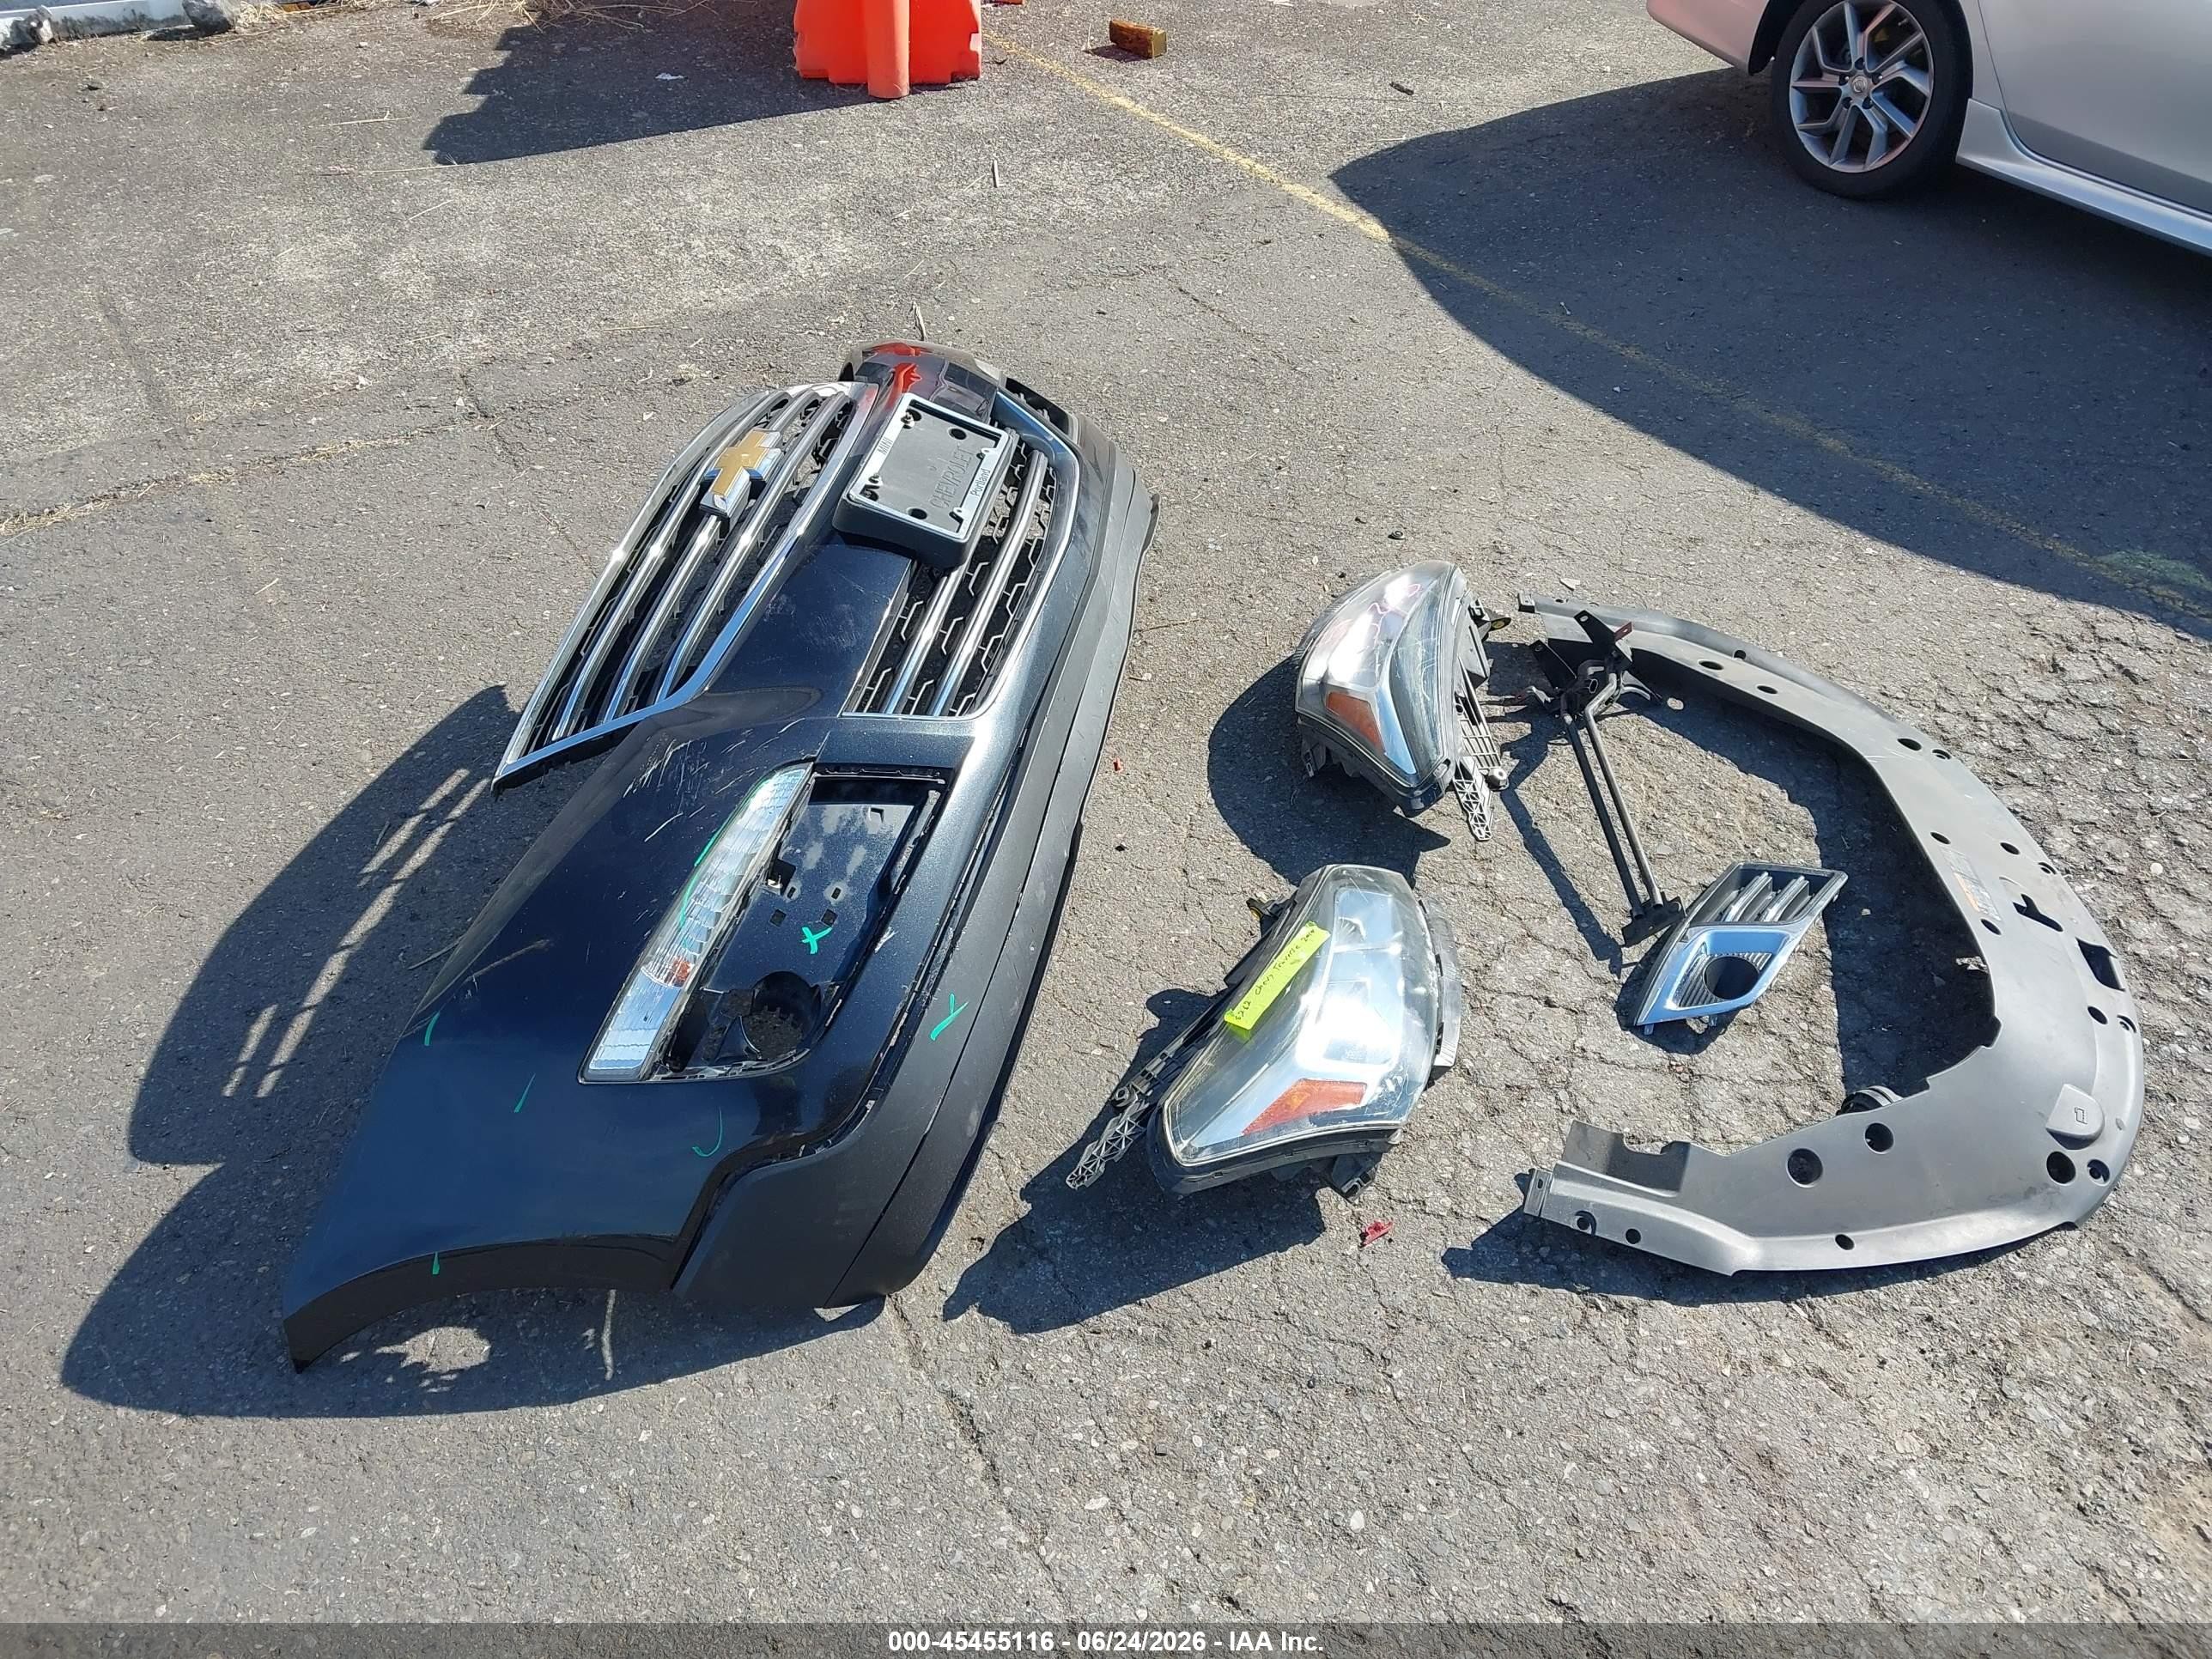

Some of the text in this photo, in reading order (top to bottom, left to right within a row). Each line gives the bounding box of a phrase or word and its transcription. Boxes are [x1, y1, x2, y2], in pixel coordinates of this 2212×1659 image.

[877, 437, 894, 455] MINI
[928, 445, 975, 509] CHEVROLET
[969, 468, 991, 496] Portland
